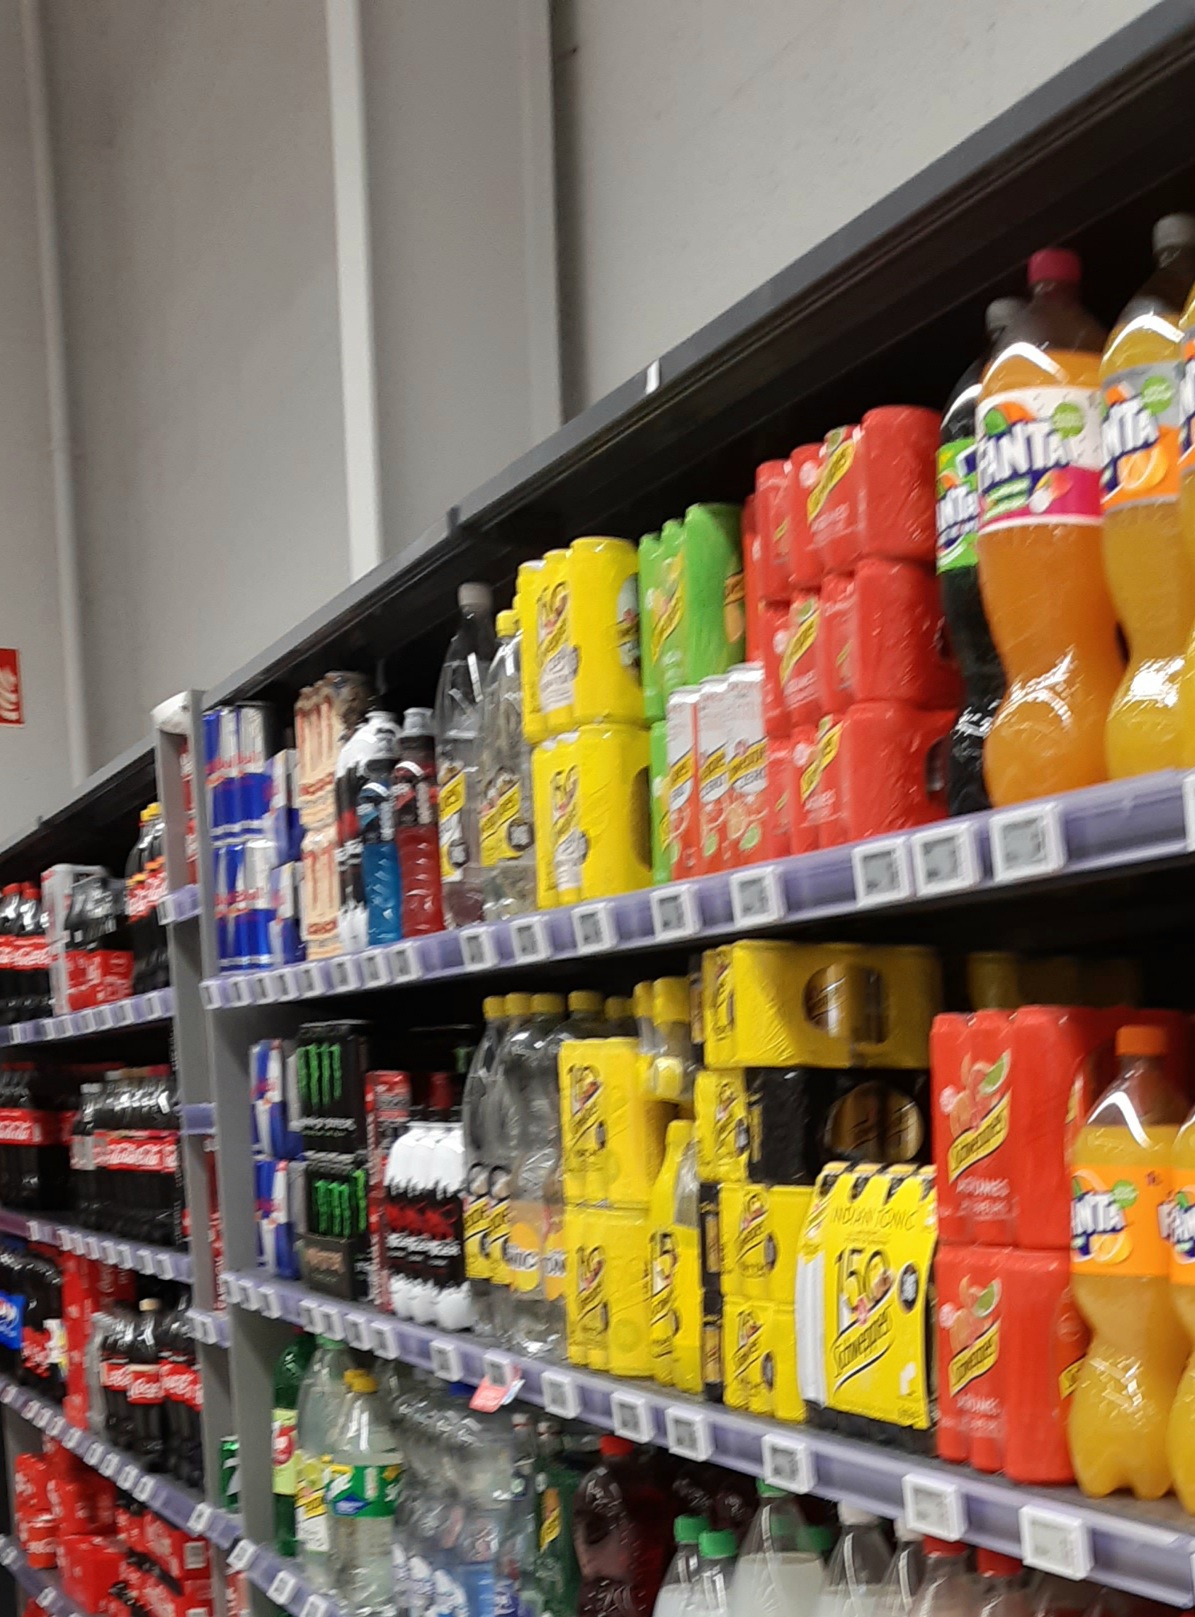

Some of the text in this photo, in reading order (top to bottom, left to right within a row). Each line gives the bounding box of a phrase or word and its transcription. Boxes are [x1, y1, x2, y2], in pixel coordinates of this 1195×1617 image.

[979, 422, 1071, 495] ANTA
[1101, 397, 1161, 470] NTA
[1072, 1194, 1127, 1237] NTA
